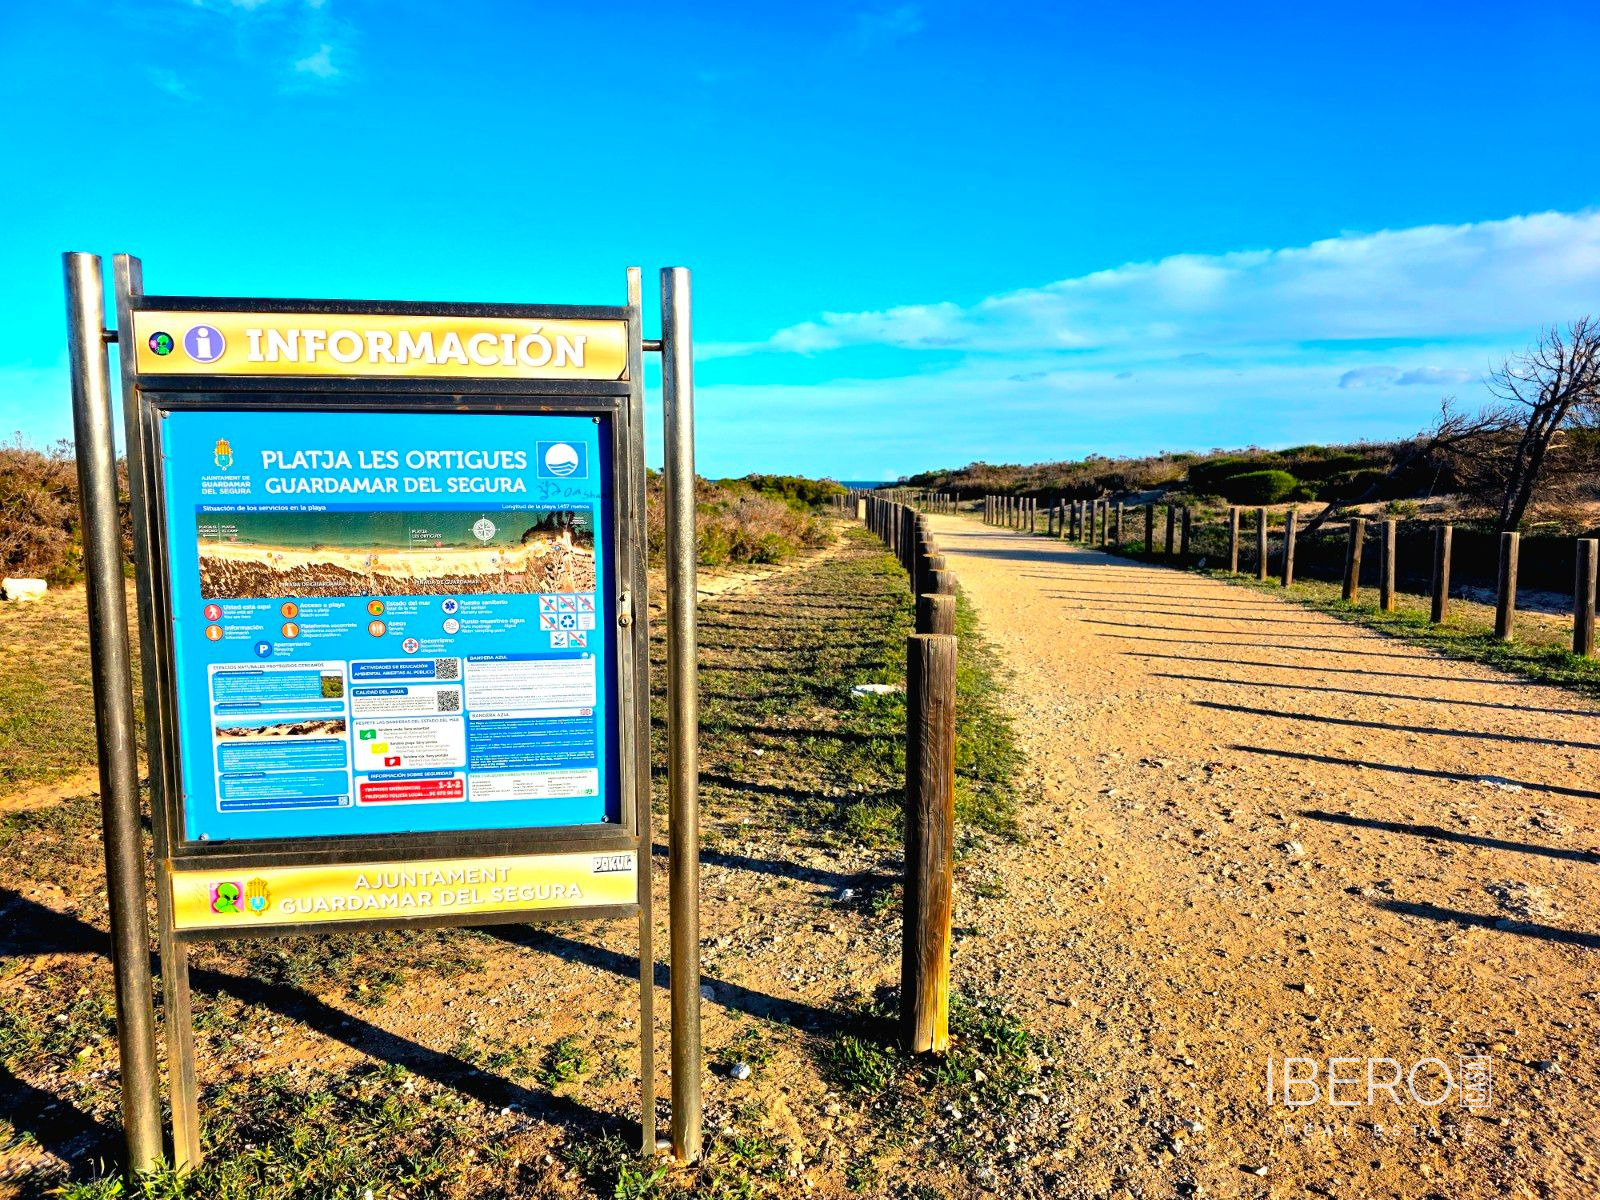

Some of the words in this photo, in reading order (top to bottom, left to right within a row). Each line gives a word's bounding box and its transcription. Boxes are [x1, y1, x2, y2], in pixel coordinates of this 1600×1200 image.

[246, 326, 587, 368] INFORMACIÓN
[261, 450, 352, 469] PLATJA
[358, 450, 399, 469] LES
[405, 449, 527, 470] ORTIGUES
[265, 477, 398, 493] GUARDAMAR
[403, 477, 442, 493] DEL
[447, 477, 527, 493] SEGURA
[438, 781, 461, 789] 1-1-2
[353, 866, 512, 890] AJUNTAMENT
[279, 890, 433, 915] GUARDAMAR
[440, 888, 485, 907] DEL
[491, 883, 584, 903] SEGURA
